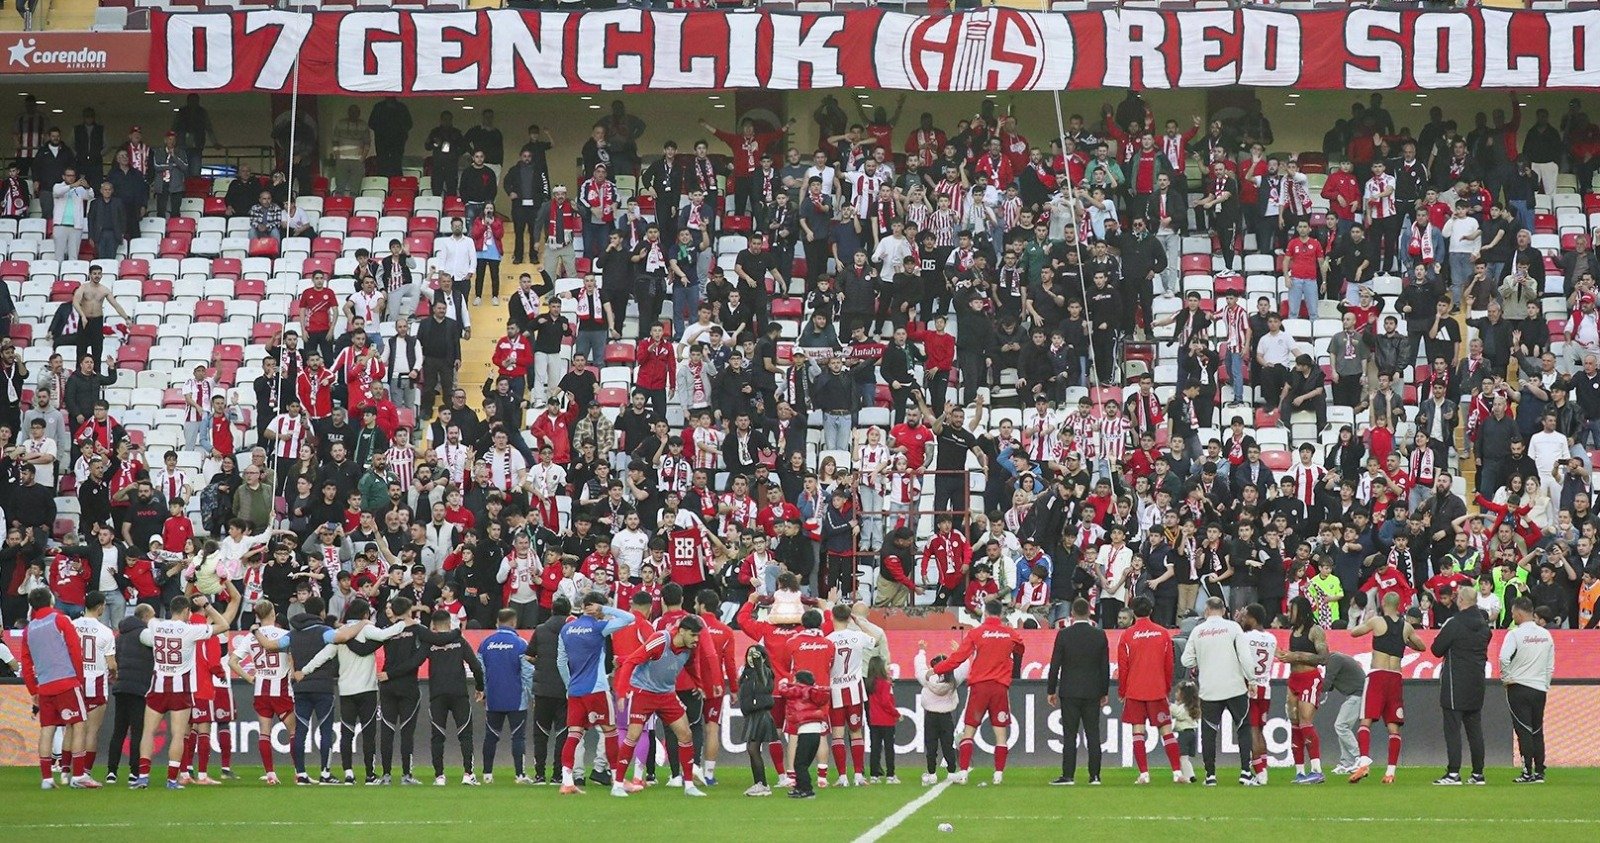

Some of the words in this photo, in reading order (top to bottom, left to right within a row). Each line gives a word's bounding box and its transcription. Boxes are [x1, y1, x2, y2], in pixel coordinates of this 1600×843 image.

[33, 47, 107, 64] corendon
[167, 10, 303, 90] 07
[1102, 9, 1300, 88] RED
[852, 347, 883, 357] Antalya
[674, 537, 695, 559] 88
[154, 635, 182, 665] 88
[837, 647, 853, 675] 7
[1254, 648, 1270, 676] 3
